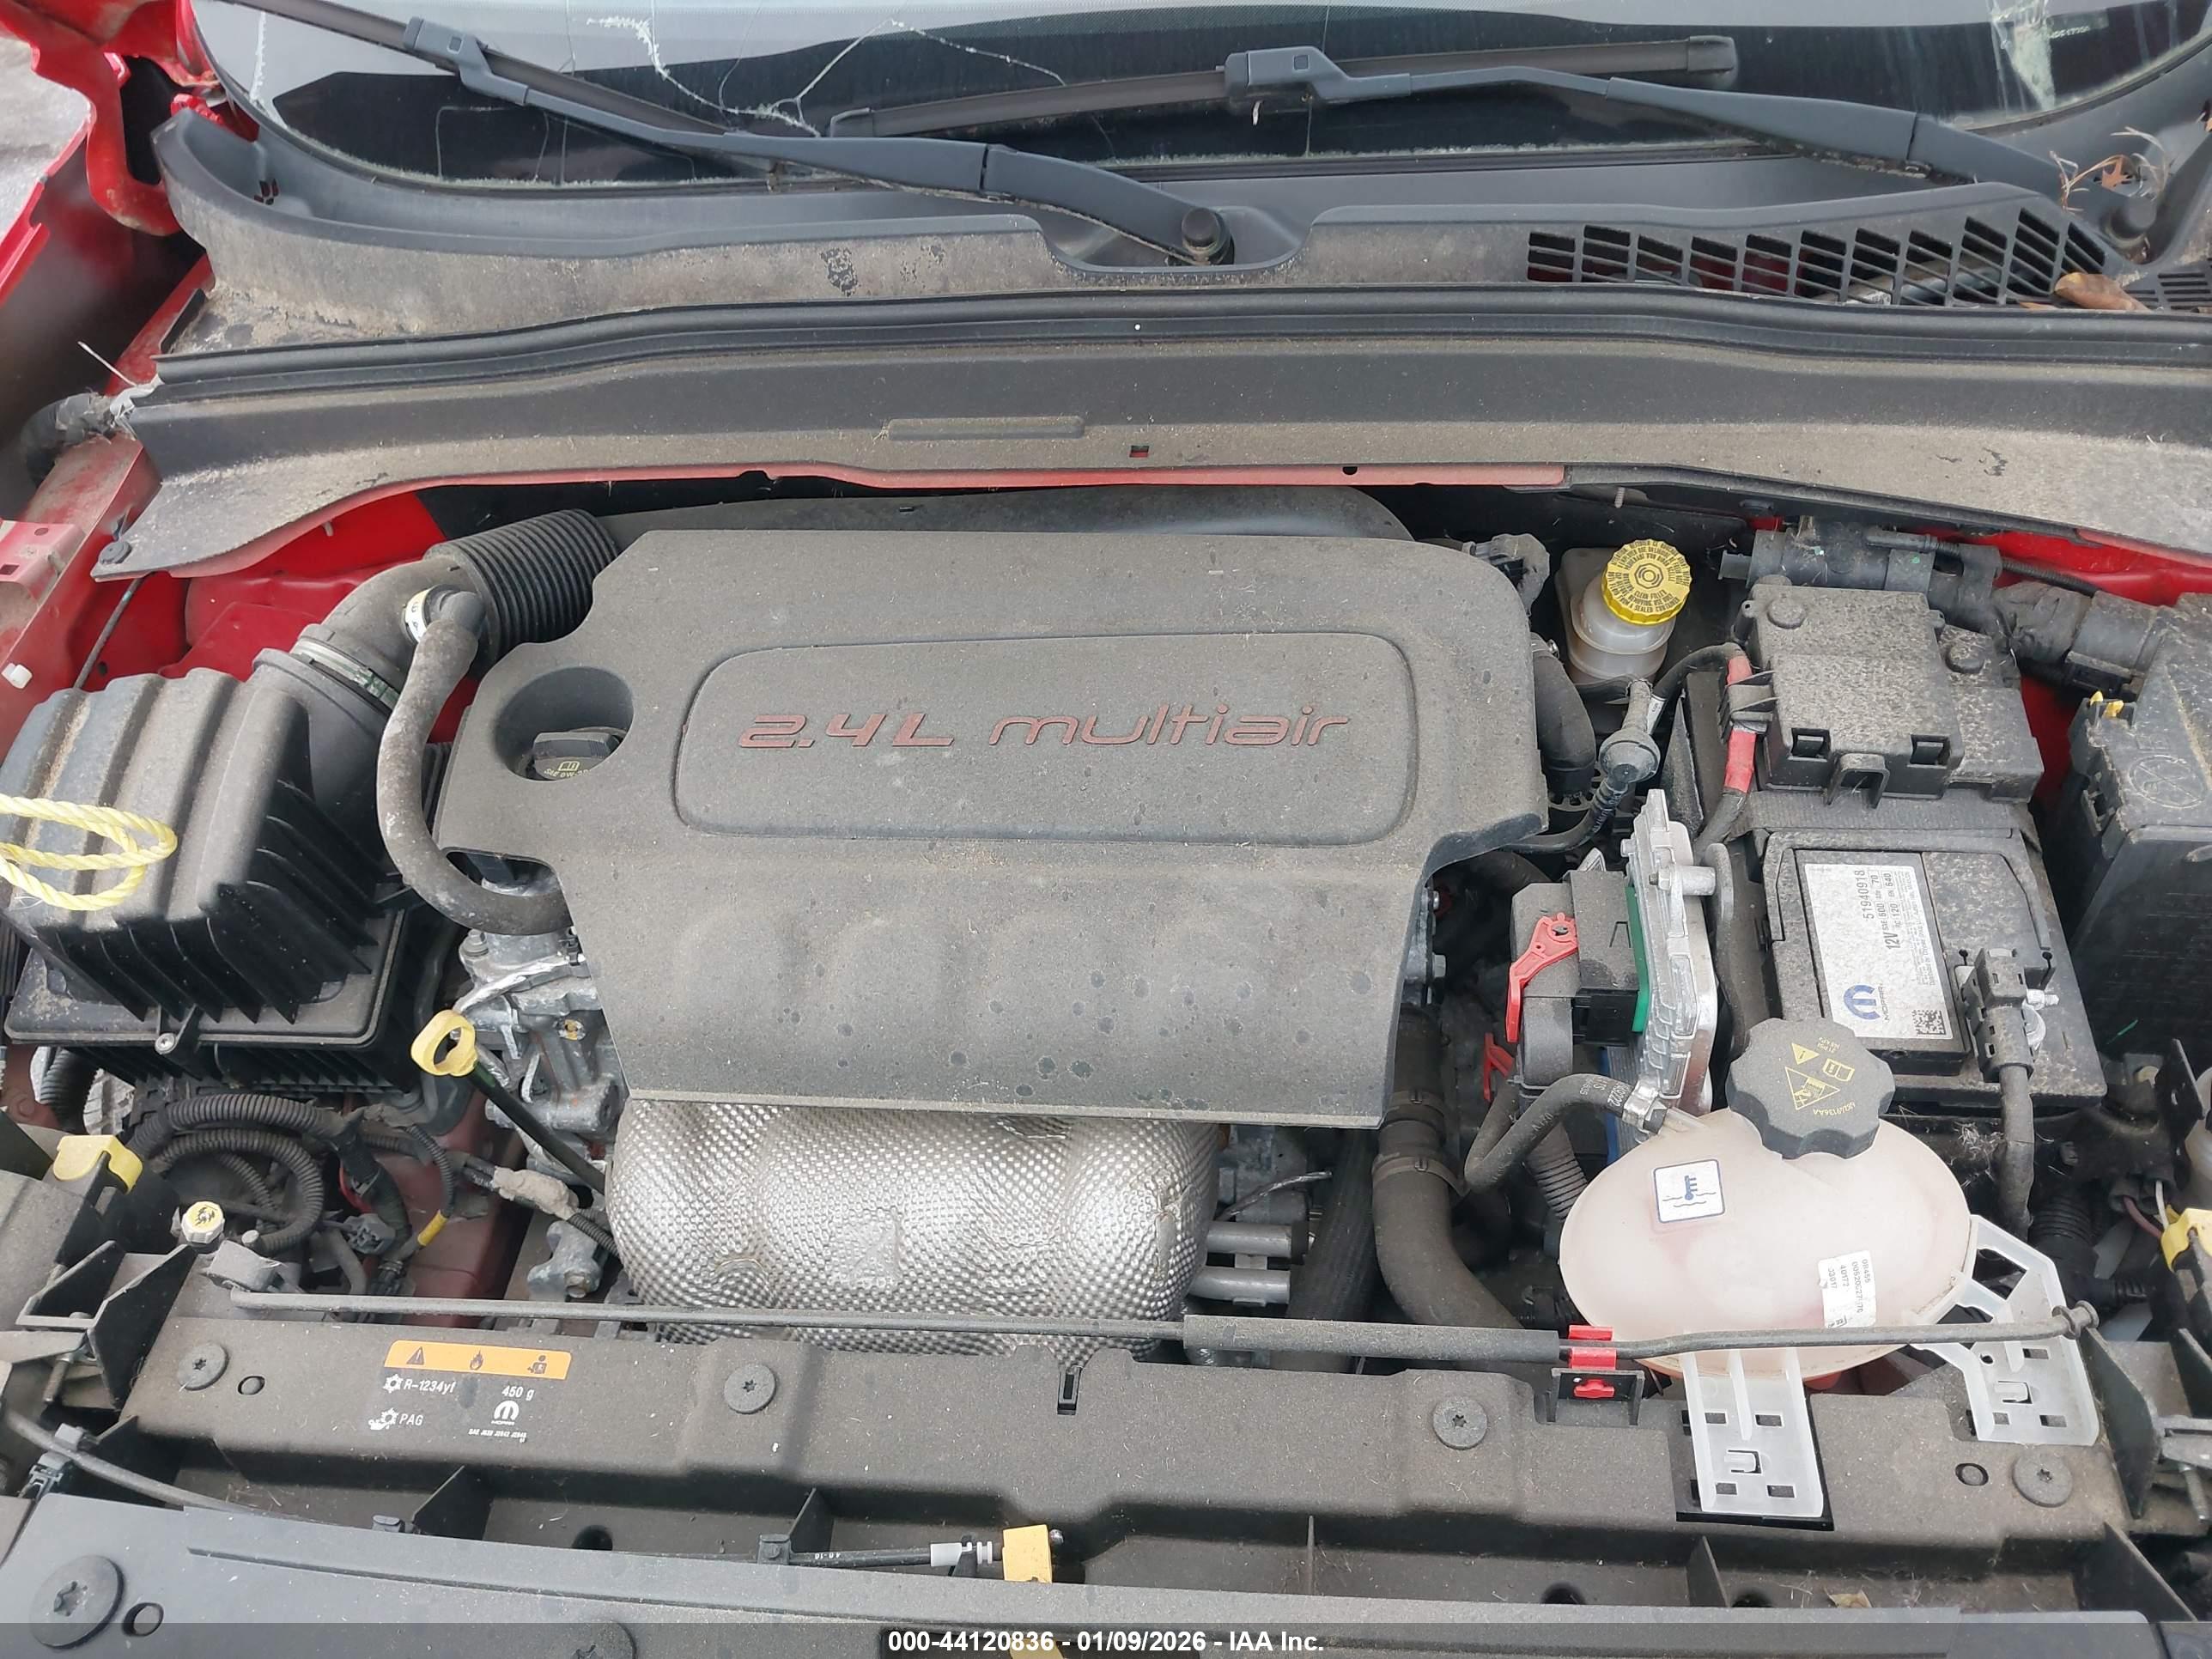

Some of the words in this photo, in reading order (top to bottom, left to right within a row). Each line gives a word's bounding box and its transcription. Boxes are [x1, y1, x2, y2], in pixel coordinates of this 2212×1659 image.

[988, 702, 1351, 746] multiair
[1870, 874, 1880, 884] 70
[1882, 872, 1893, 887] 640
[1855, 870, 1875, 919] 51940918
[1889, 903, 1900, 917] 120
[1882, 932, 1901, 950] 12V
[1878, 985, 1890, 1022] MOPAR
[404, 1377, 456, 1395] R-1234yf
[501, 1384, 523, 1398] 450
[526, 1389, 535, 1401] g
[398, 1413, 424, 1426] PAG
